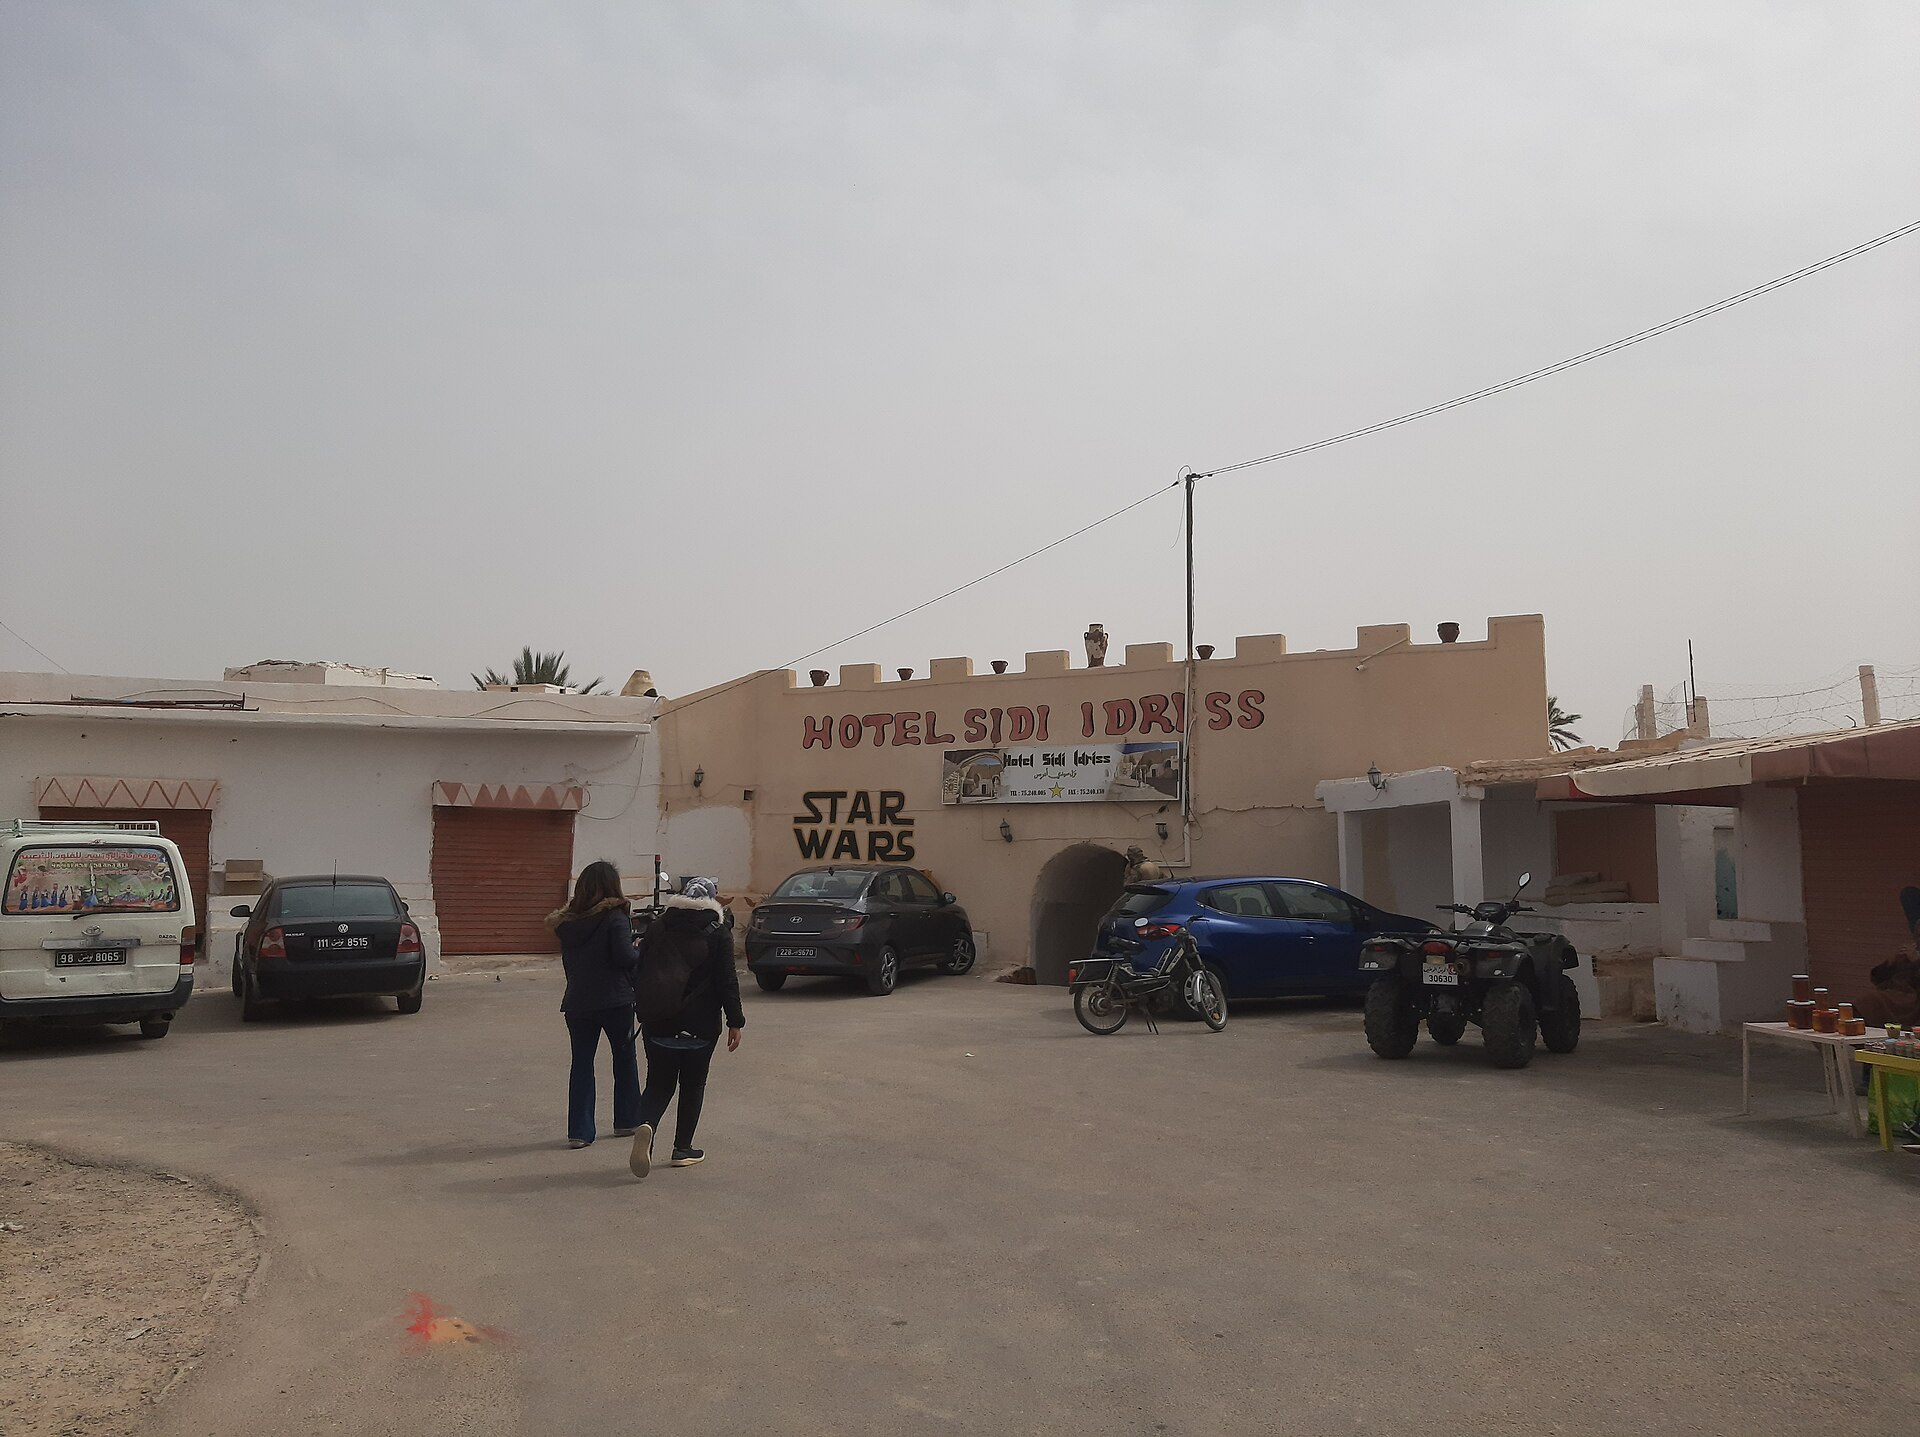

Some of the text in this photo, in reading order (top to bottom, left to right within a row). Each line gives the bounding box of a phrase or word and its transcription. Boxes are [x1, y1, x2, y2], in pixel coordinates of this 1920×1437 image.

[802, 689, 1266, 750] HOTEL SIDI IDRISS
[1003, 749, 1111, 768] Hotel Sidi Idriss
[793, 790, 915, 826] STAR
[793, 828, 915, 862] WARS
[317, 938, 329, 948] 111
[347, 937, 368, 947] 8515
[60, 953, 74, 964] 98
[95, 951, 119, 962] 8065
[780, 948, 792, 956] 228
[1428, 974, 1453, 983] 30630
